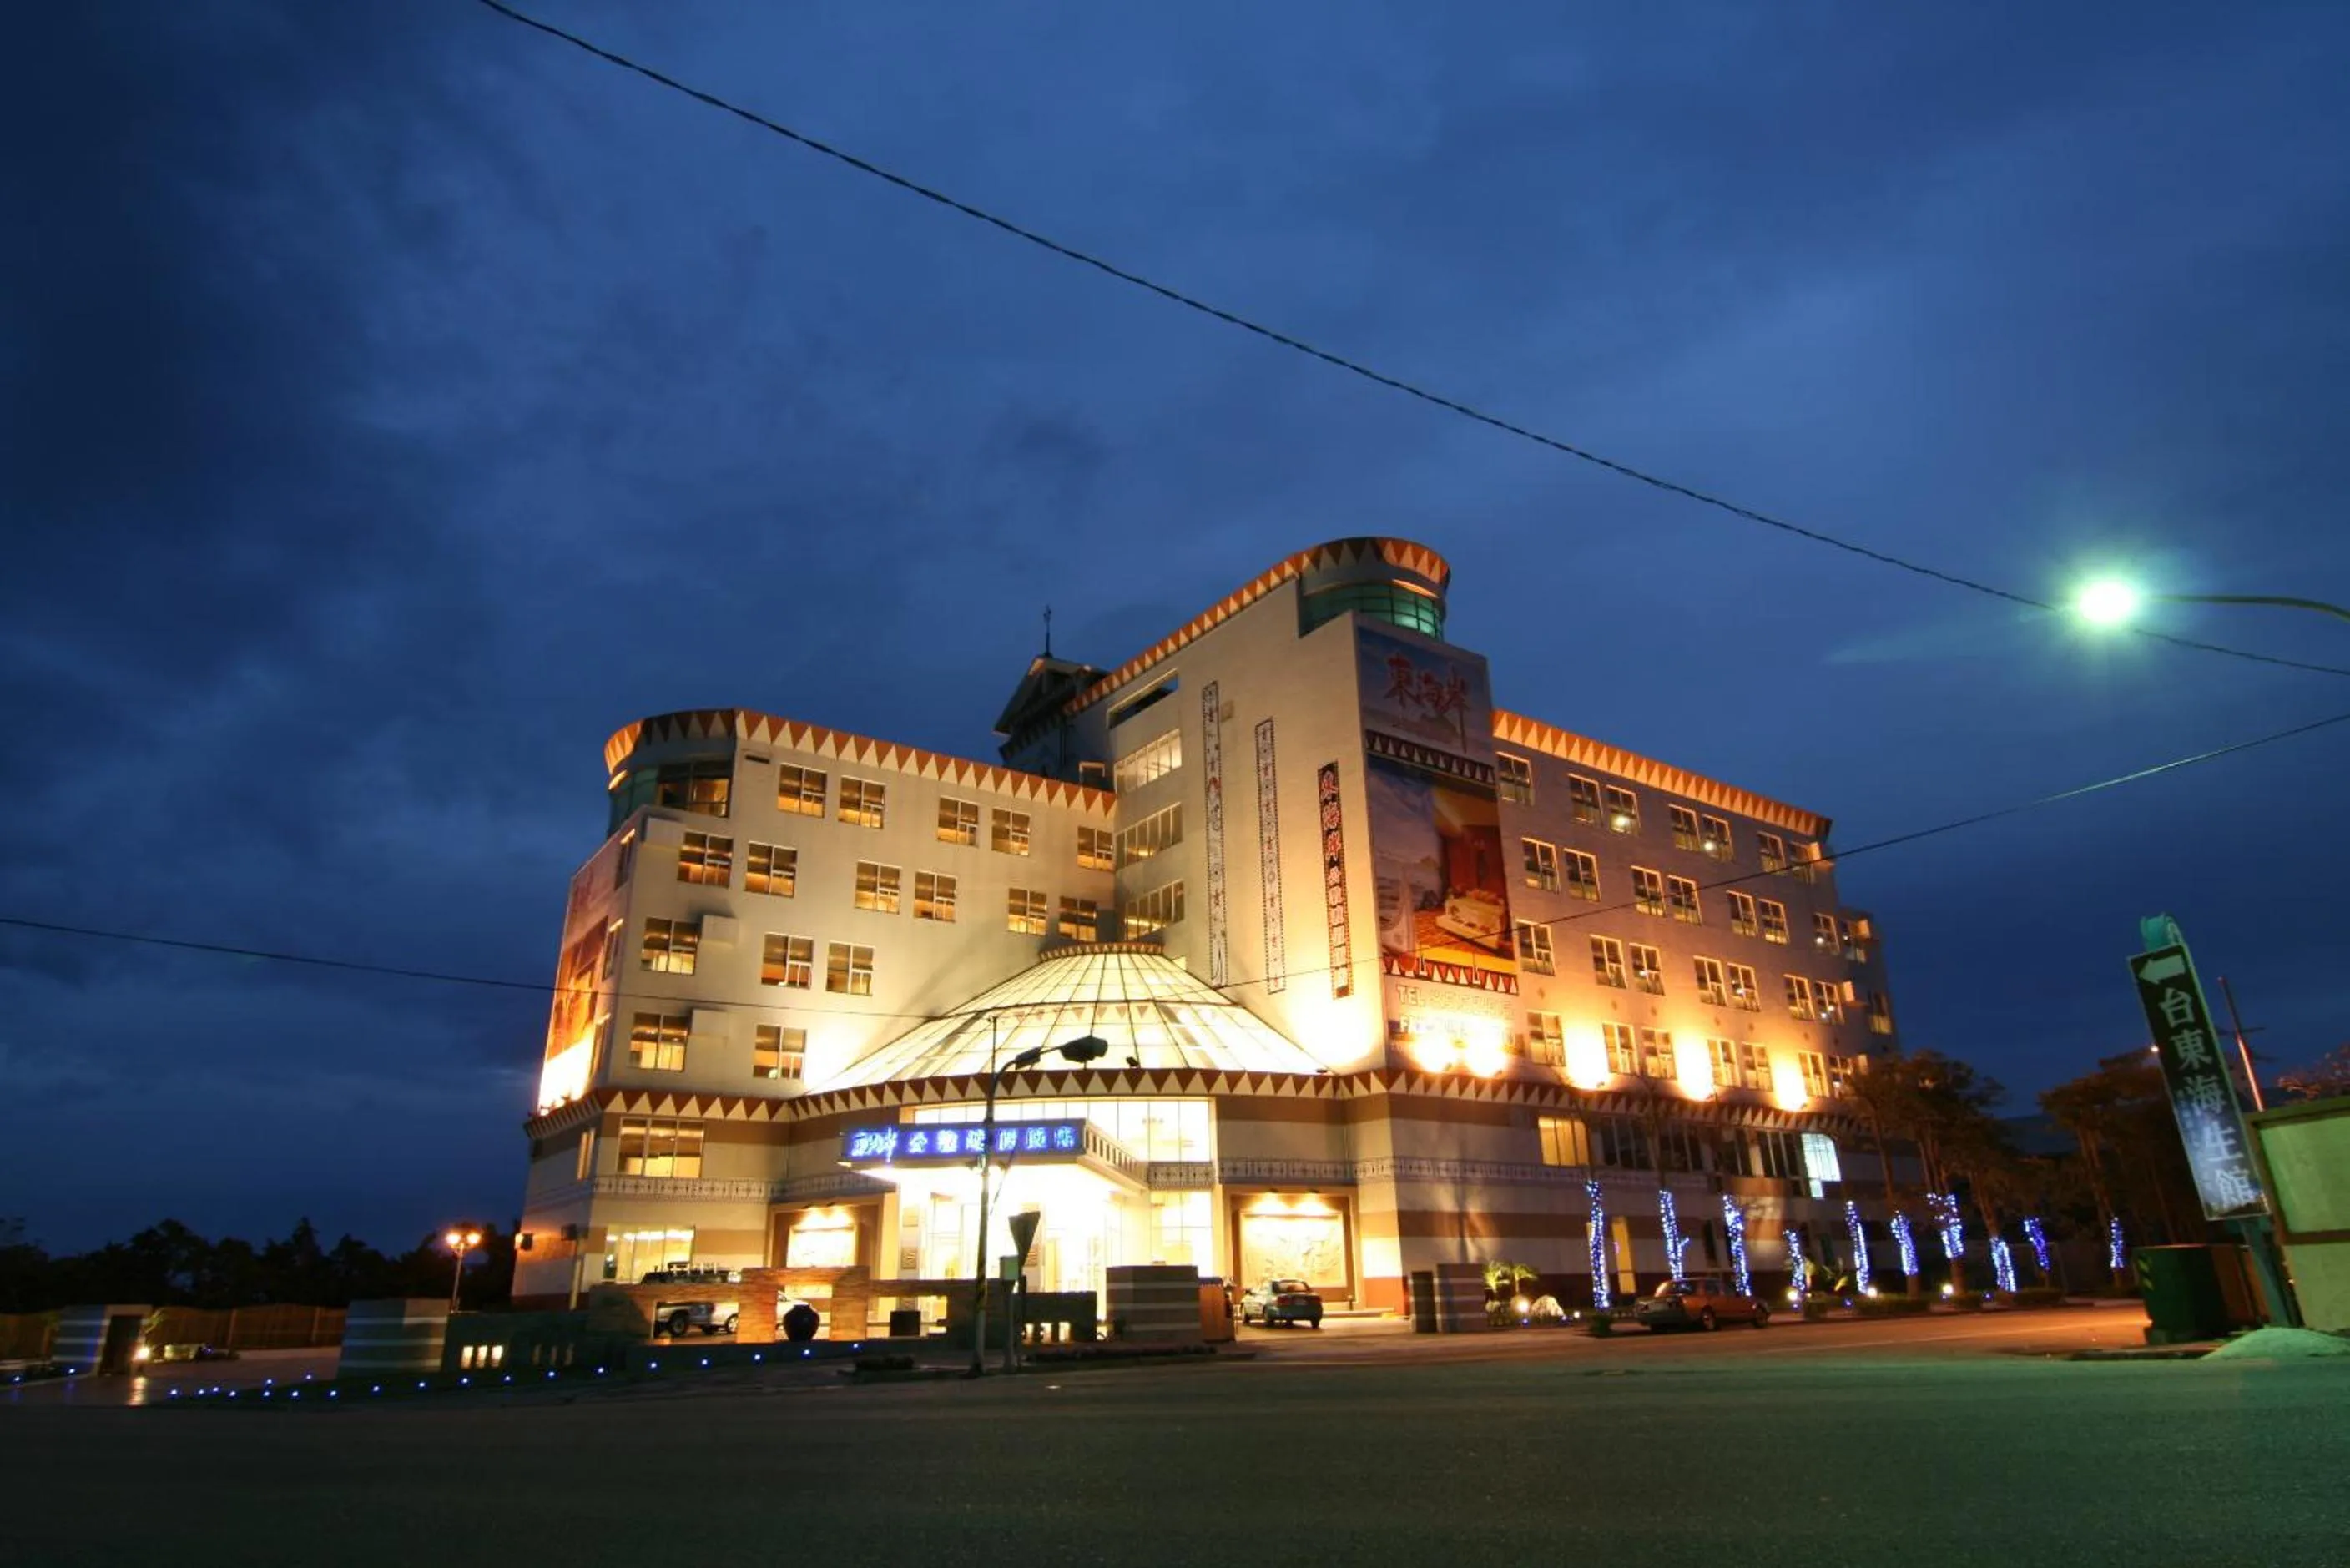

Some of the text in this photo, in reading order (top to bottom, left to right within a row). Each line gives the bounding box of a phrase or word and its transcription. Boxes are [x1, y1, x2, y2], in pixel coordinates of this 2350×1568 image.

[2159, 987, 2256, 1208] 台東海生館
